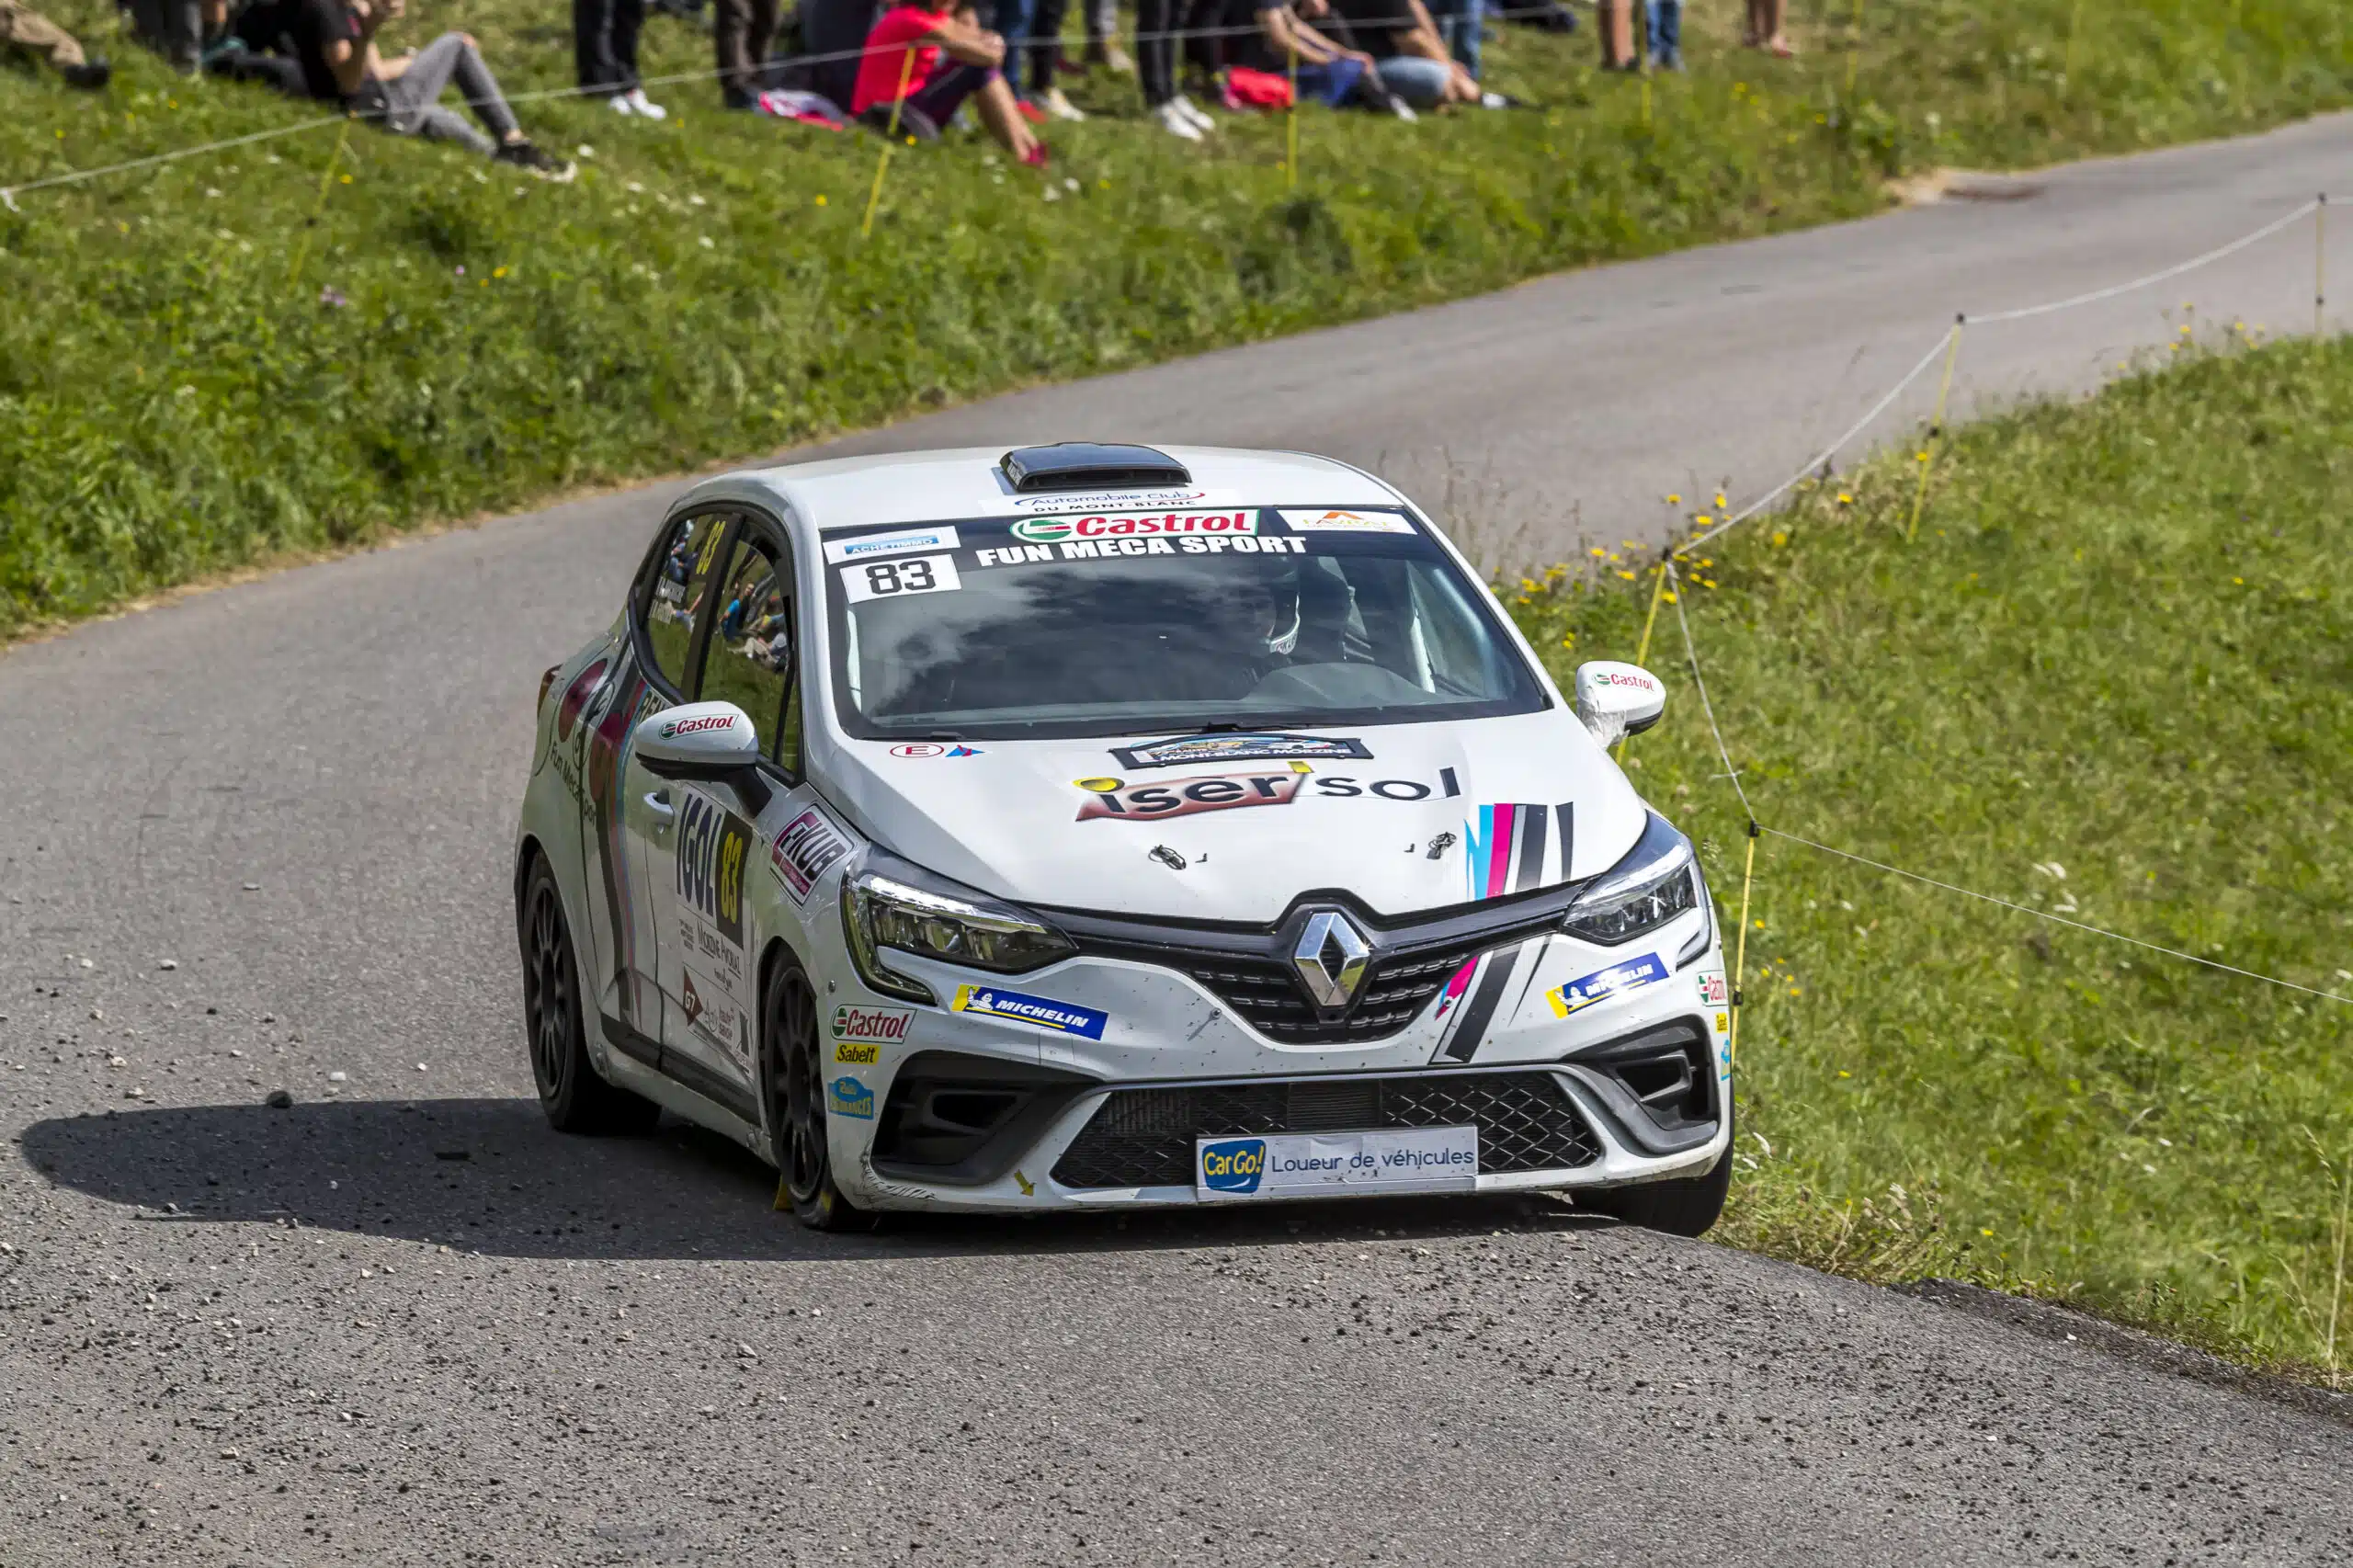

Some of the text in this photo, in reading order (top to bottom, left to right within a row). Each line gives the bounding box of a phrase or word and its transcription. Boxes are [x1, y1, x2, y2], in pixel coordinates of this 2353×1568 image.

[1031, 491, 1190, 506] Automobile Club
[1076, 512, 1251, 536] Castrol
[696, 520, 726, 574] 83
[975, 536, 1307, 567] FUN MECA SPORT
[865, 560, 937, 595] 83
[1611, 674, 1655, 692] Castrol
[676, 714, 734, 735] Castrol
[1160, 748, 1270, 761] MONT-BLANC
[676, 793, 743, 925] IGOL 83
[845, 1008, 910, 1039] Castrol
[995, 1000, 1089, 1028] MICHELIN
[837, 1045, 876, 1062] Sabelt
[1203, 1145, 1474, 1176] CarGo! Loueur de véhicules
